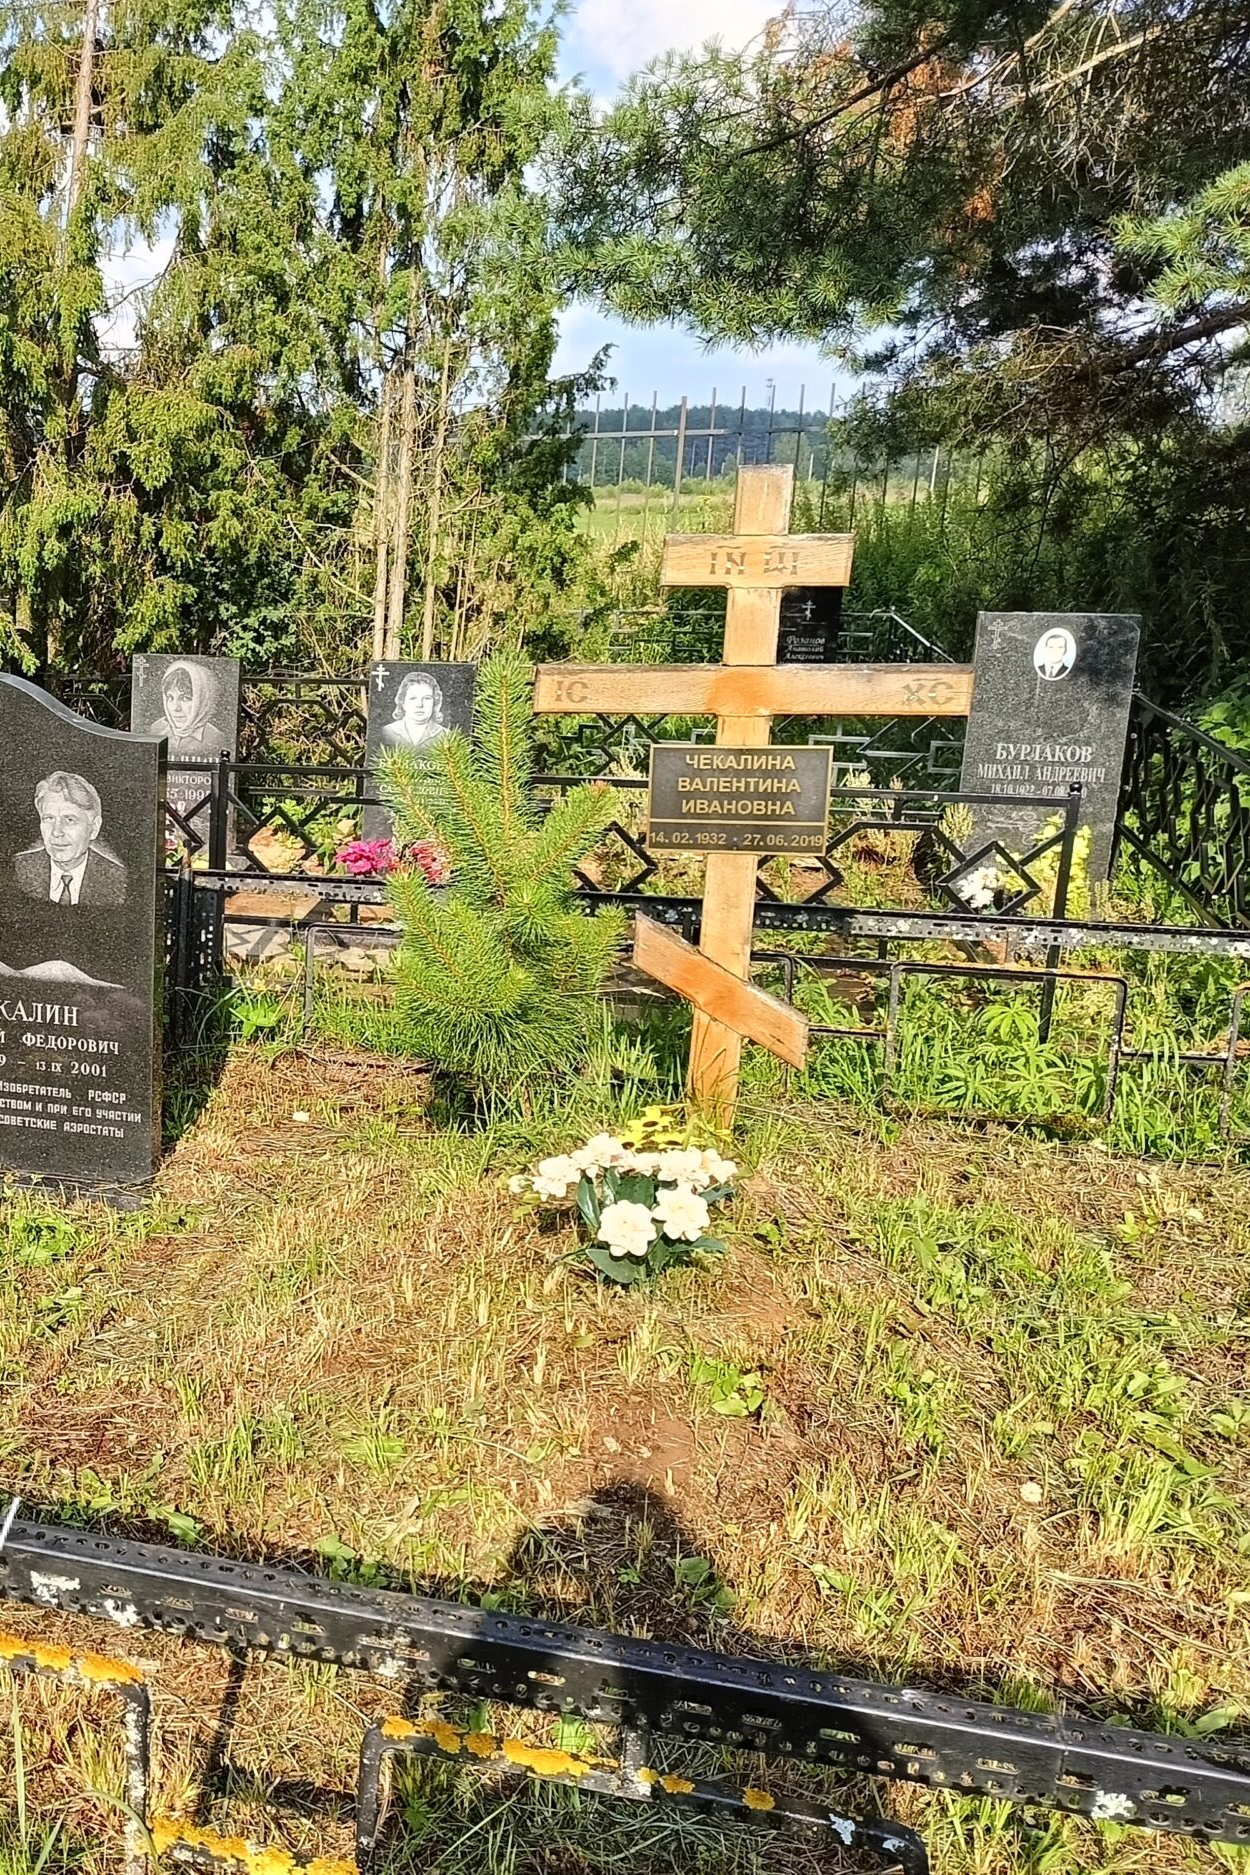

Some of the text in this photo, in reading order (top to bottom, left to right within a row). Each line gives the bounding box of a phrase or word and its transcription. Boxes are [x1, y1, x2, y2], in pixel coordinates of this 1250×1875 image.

[995, 743, 1093, 763] БУРЛАКОВ
[685, 754, 796, 770] ЧЕКАЛИНА
[976, 763, 1106, 783] МИХАИЛ АНДРЕЕВИЧ
[677, 777, 801, 793] ВАЛЕНТИНА
[681, 799, 796, 815] ИВАНОВНА
[22, 1032, 119, 1055] ФЕДОРОВИЧ
[70, 1062, 108, 1078] 2001
[88, 1090, 127, 1105] РСФСР
[35, 1101, 43, 1113] И
[47, 1103, 67, 1116] ПРИ
[72, 1105, 93, 1117] ЕГО
[96, 1109, 142, 1124] УЧАСТИИ
[63, 1121, 125, 1139] АЭРОСТАТЫ
